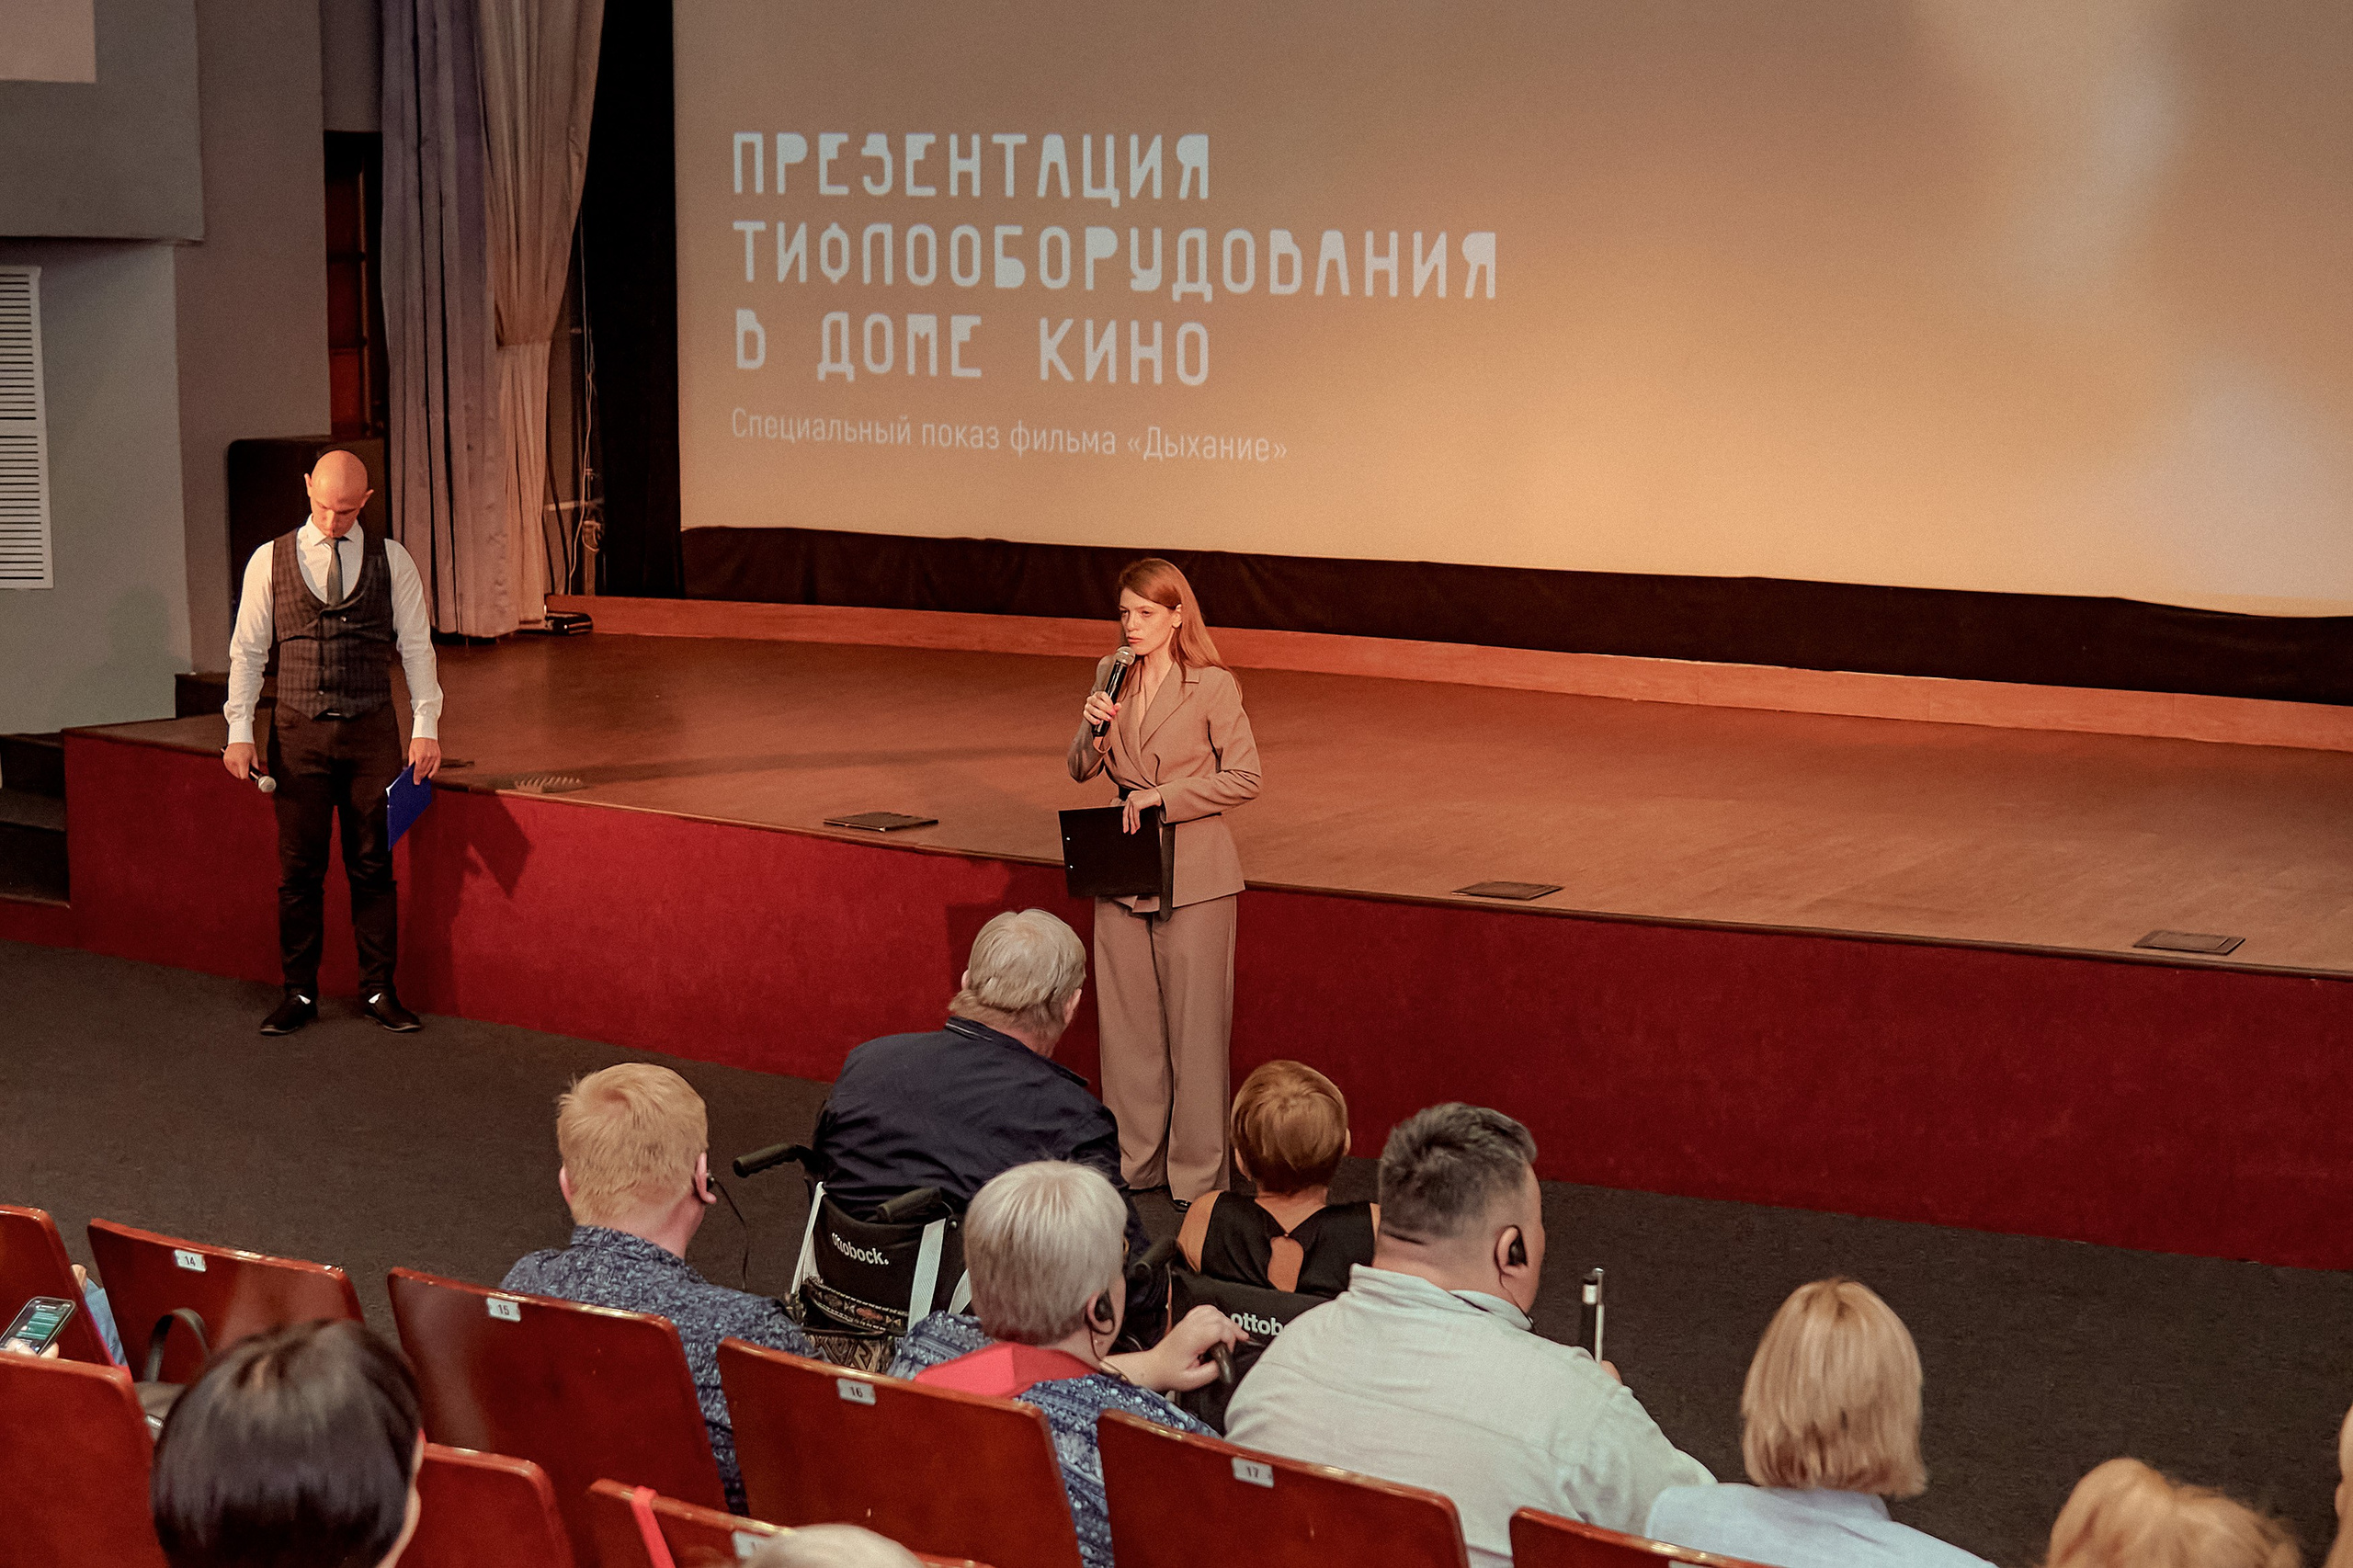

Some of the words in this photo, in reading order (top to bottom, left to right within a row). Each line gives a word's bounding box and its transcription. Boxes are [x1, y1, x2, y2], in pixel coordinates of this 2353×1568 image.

[733, 131, 1210, 209] ПРЕЗЕНТАЦИЯ
[732, 220, 1497, 302] ТИФЛООБОРУДОВАНИЯ
[735, 308, 767, 369] В
[816, 311, 983, 382] ДОМЕ
[1040, 317, 1210, 386] КИНО
[732, 406, 912, 445] Специальный
[921, 422, 1000, 449] показ
[1010, 419, 1116, 459] фильма
[1127, 426, 1288, 461] «Дыхание»
[184, 1256, 196, 1267] 14
[498, 1303, 510, 1316] 15
[849, 1386, 863, 1398] 16
[1245, 1466, 1259, 1479] 17
